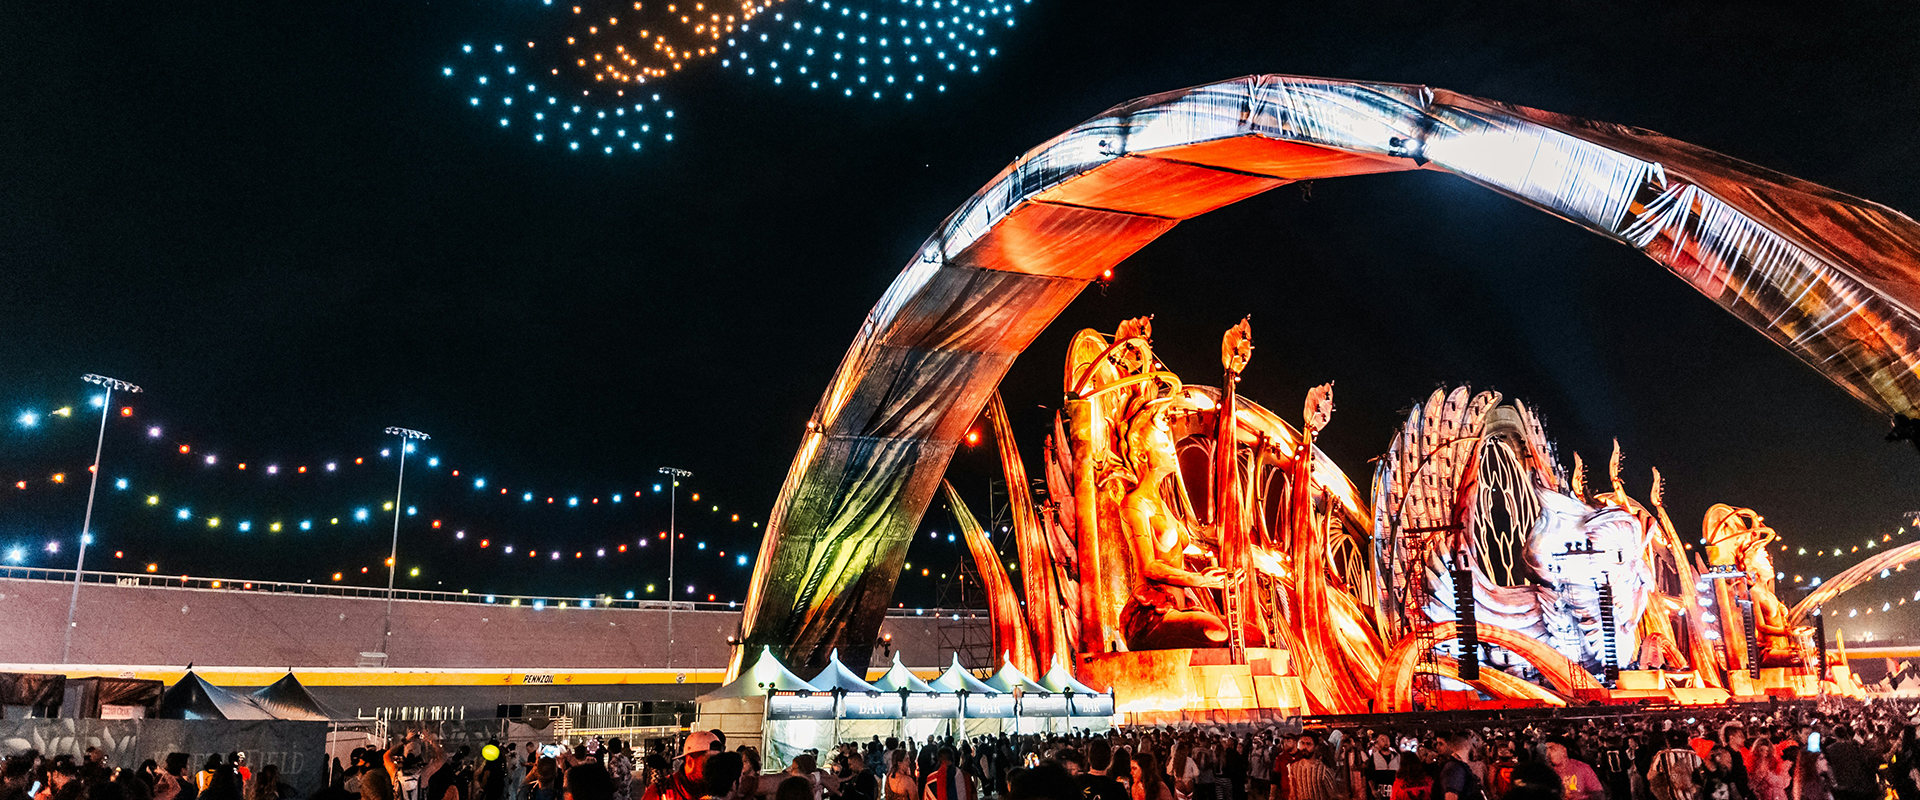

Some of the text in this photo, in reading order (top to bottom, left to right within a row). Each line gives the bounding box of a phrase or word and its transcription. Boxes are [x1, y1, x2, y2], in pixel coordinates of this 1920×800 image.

[523, 674, 554, 683] PENNZOIL
[858, 702, 885, 715] BAR
[980, 703, 1001, 714] BAR
[1083, 703, 1101, 713] BAR
[246, 749, 304, 774] FIELD
